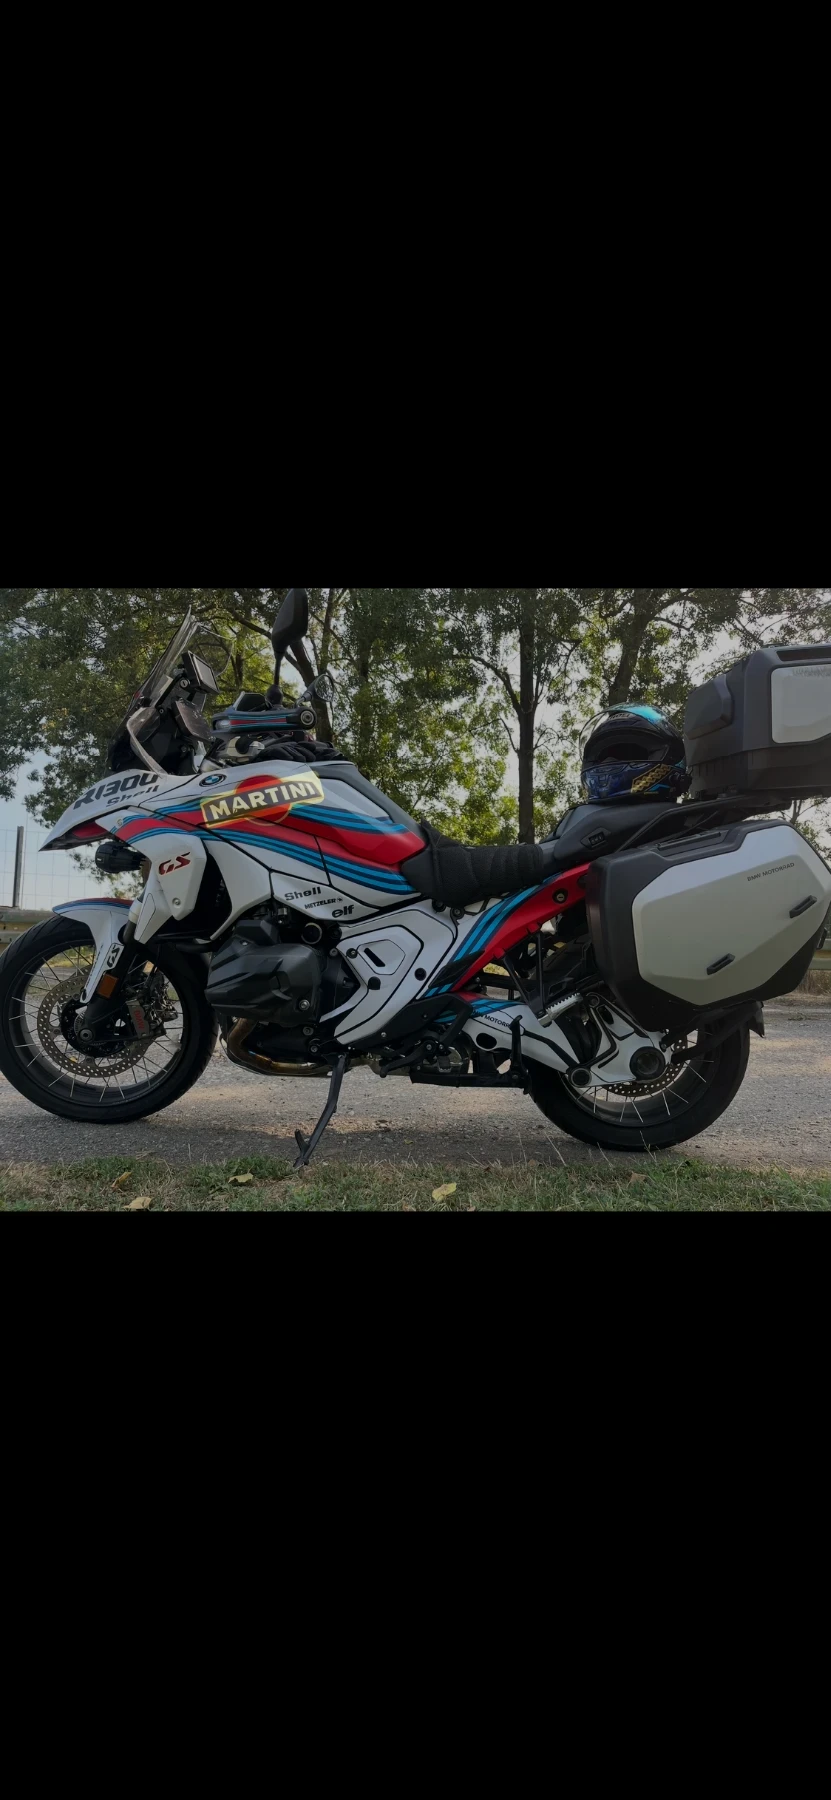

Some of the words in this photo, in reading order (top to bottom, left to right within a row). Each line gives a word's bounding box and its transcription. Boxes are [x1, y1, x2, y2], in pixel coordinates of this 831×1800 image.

[106, 785, 160, 807] Shell
[209, 783, 316, 820] MARTINI
[158, 852, 191, 875] GS
[762, 862, 795, 877] MOTORRAD
[284, 886, 322, 901] Shell
[304, 898, 336, 909] METZELER
[331, 904, 355, 918] elf
[484, 1014, 511, 1028] MOTORR
